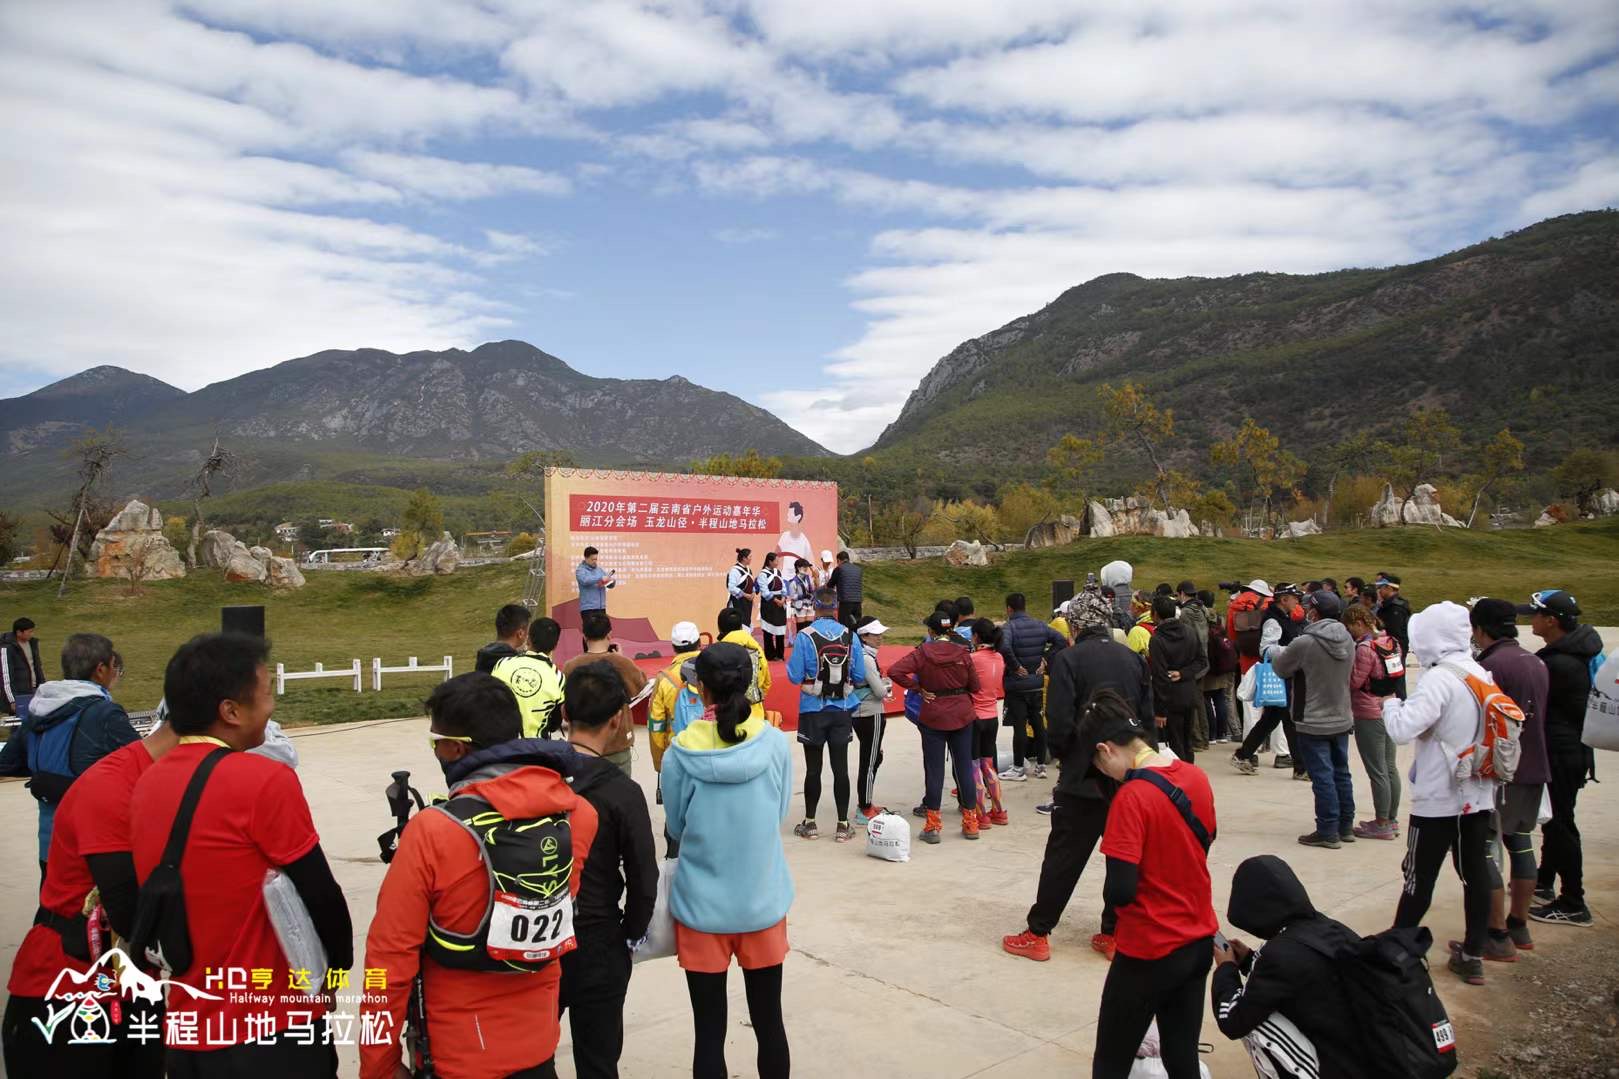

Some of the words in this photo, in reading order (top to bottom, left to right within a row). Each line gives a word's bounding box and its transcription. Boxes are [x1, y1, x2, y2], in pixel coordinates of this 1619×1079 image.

[586, 501, 761, 517] 2020年第二届云南省户外运动嘉年华
[579, 515, 637, 528] 丽江分会场
[510, 908, 563, 943] 022
